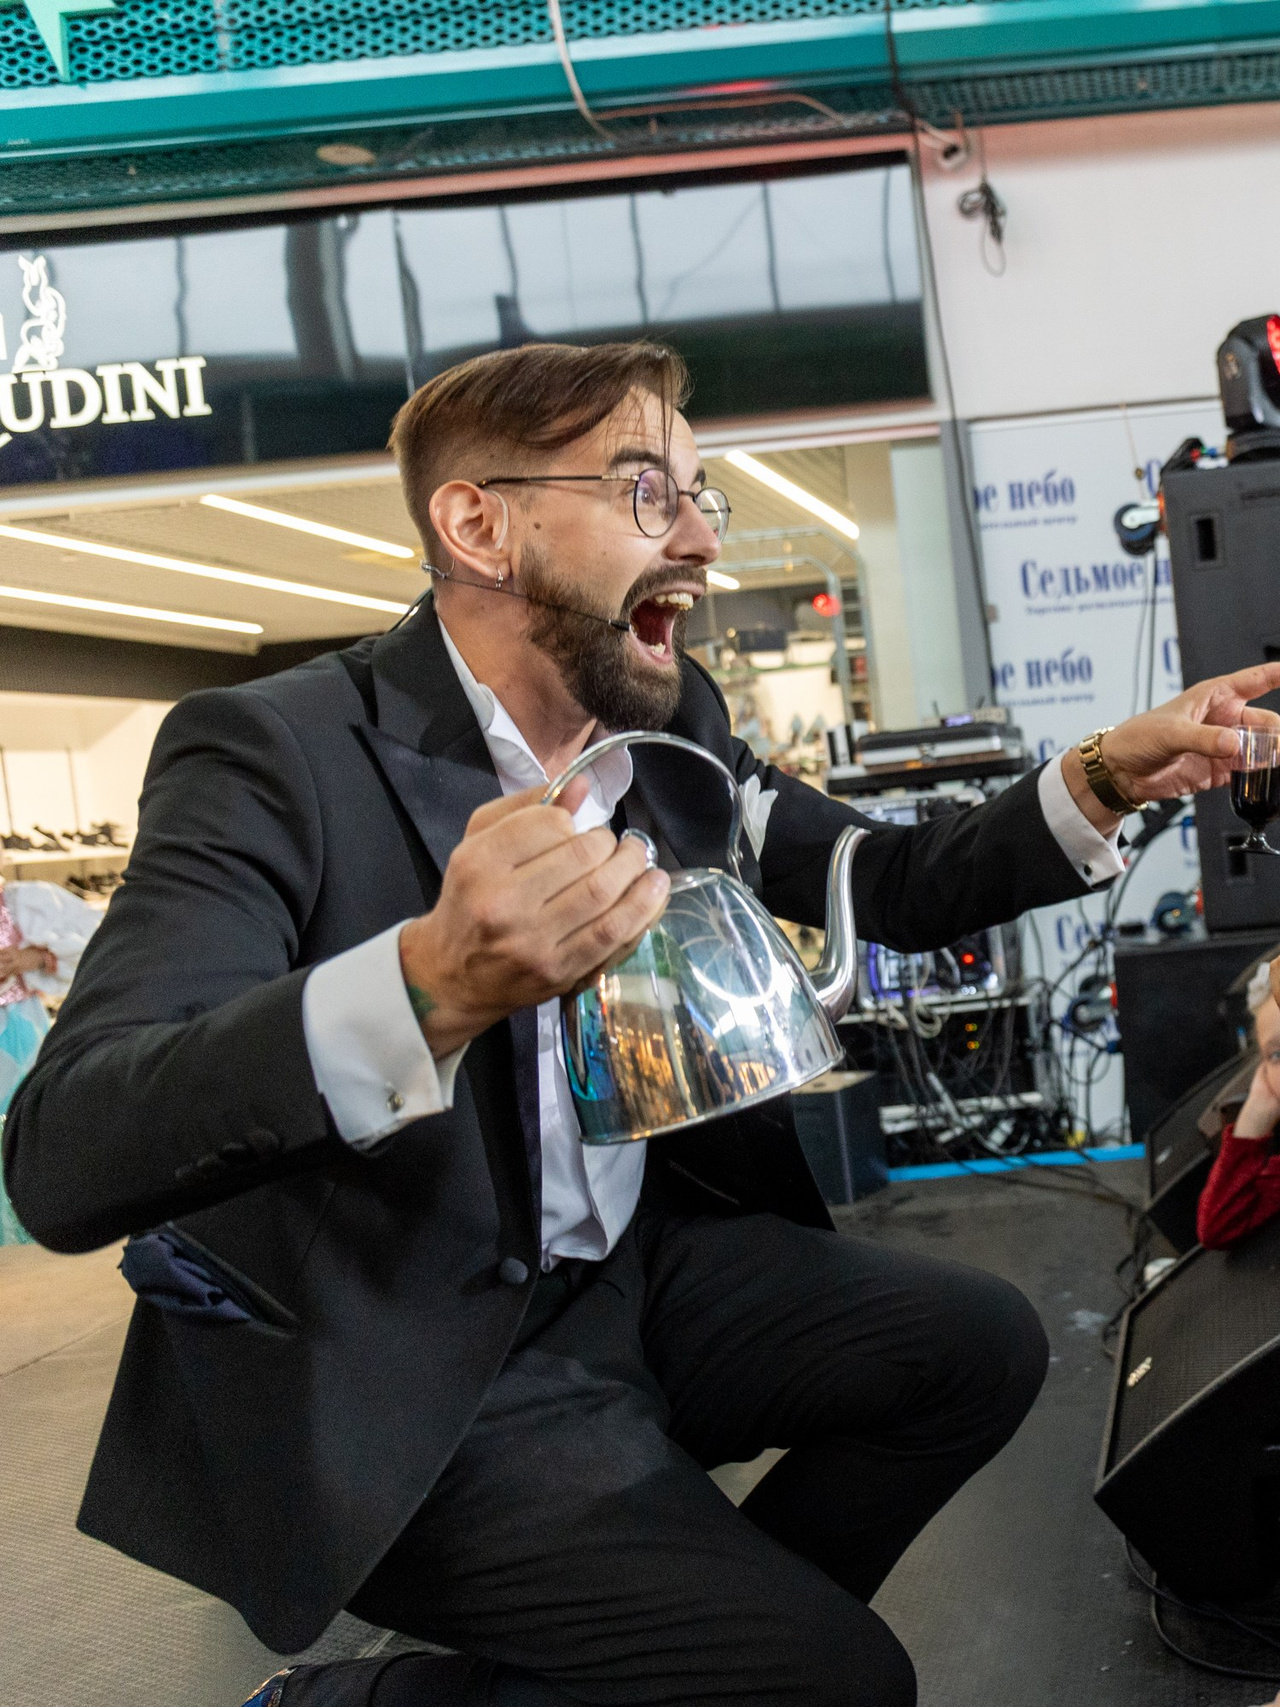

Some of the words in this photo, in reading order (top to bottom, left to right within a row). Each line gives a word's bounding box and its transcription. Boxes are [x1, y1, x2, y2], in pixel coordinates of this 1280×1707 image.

[0, 356, 212, 448] UDINI
[1008, 470, 1076, 511] небо
[1020, 560, 1145, 599] Седьмое
[1024, 648, 1093, 690] небо
